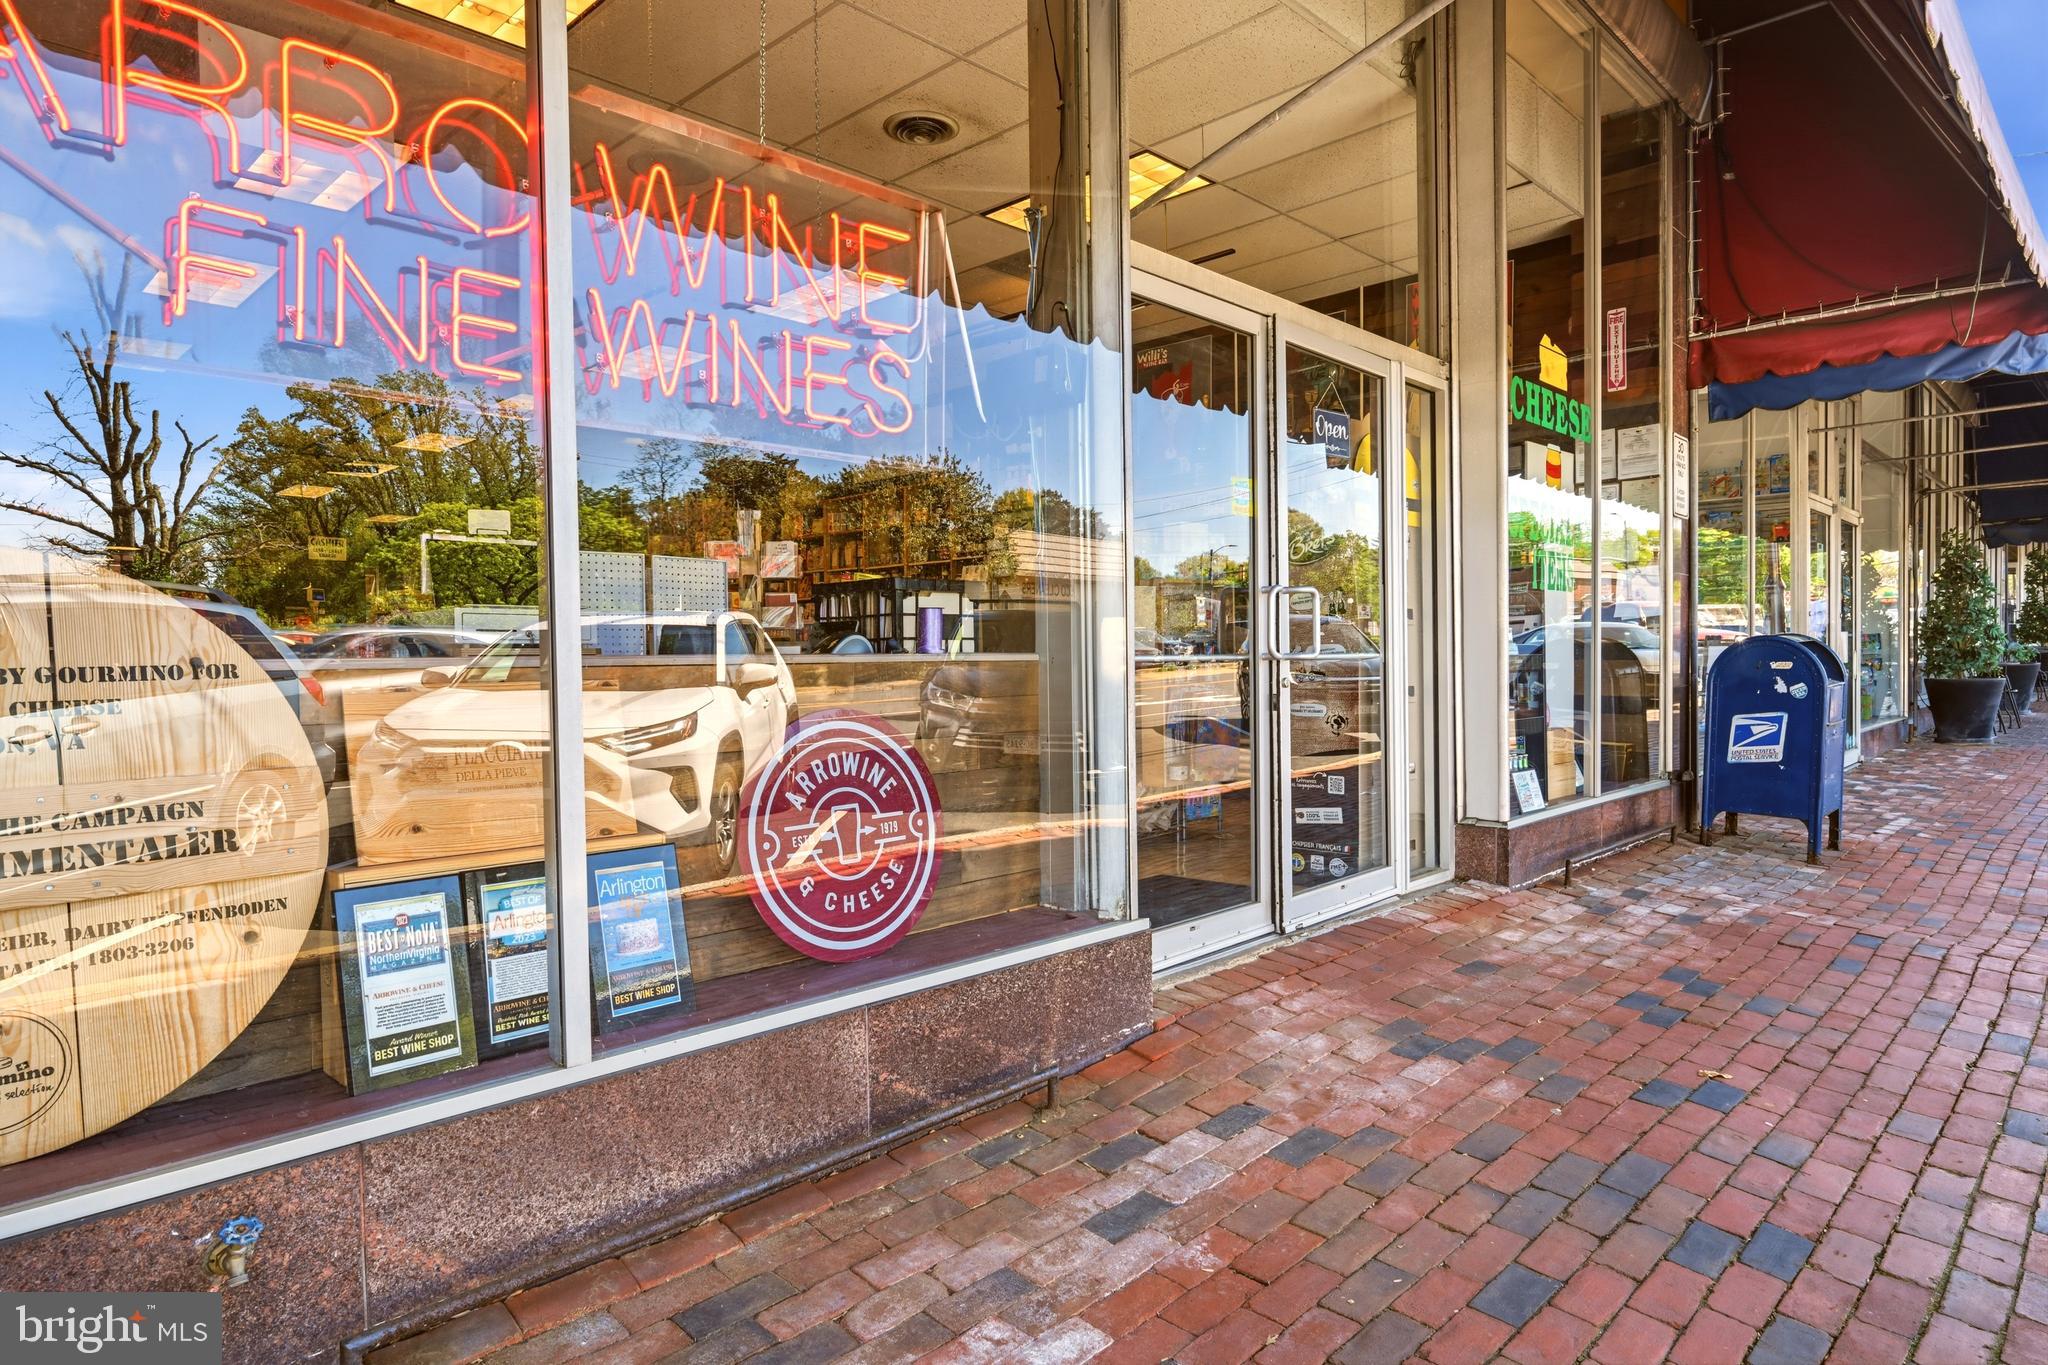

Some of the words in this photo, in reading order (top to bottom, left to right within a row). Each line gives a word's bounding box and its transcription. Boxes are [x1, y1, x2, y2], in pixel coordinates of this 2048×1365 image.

[170, 196, 524, 384] FINE
[588, 287, 914, 434] WINES
[1609, 314, 1624, 324] FIRE
[1137, 348, 1168, 364] Willi's
[1511, 375, 1592, 444] CHEESE
[1315, 414, 1349, 443] Open
[34, 663, 184, 684] GOURMINO
[192, 660, 240, 681] FOR
[9, 698, 123, 718] CHEESE
[456, 770, 492, 782] DELLA
[495, 766, 528, 778] PIEVE
[785, 751, 898, 811] ARROWINE
[50, 800, 205, 831] CAMPAIGN
[0, 828, 240, 879] MENTALER
[600, 874, 664, 897] Arlington
[799, 876, 815, 898] &
[824, 858, 904, 914] CHEESE
[64, 919, 137, 942] DAIRY
[367, 927, 399, 954] BEST
[88, 936, 195, 967] 1803-3206
[371, 955, 442, 971] MAGAZINE
[372, 987, 410, 1000] ARROWINE
[418, 980, 445, 991] CHEESE
[615, 993, 634, 1005] BEST
[635, 988, 655, 1000] WINE
[655, 983, 676, 996] SHOP
[495, 1021, 517, 1032] BEST
[518, 1016, 541, 1026] WINE
[374, 1046, 400, 1061] BEST
[400, 1040, 427, 1055] WINE
[428, 1033, 455, 1049] SHOP
[4, 1083, 54, 1100] selection
